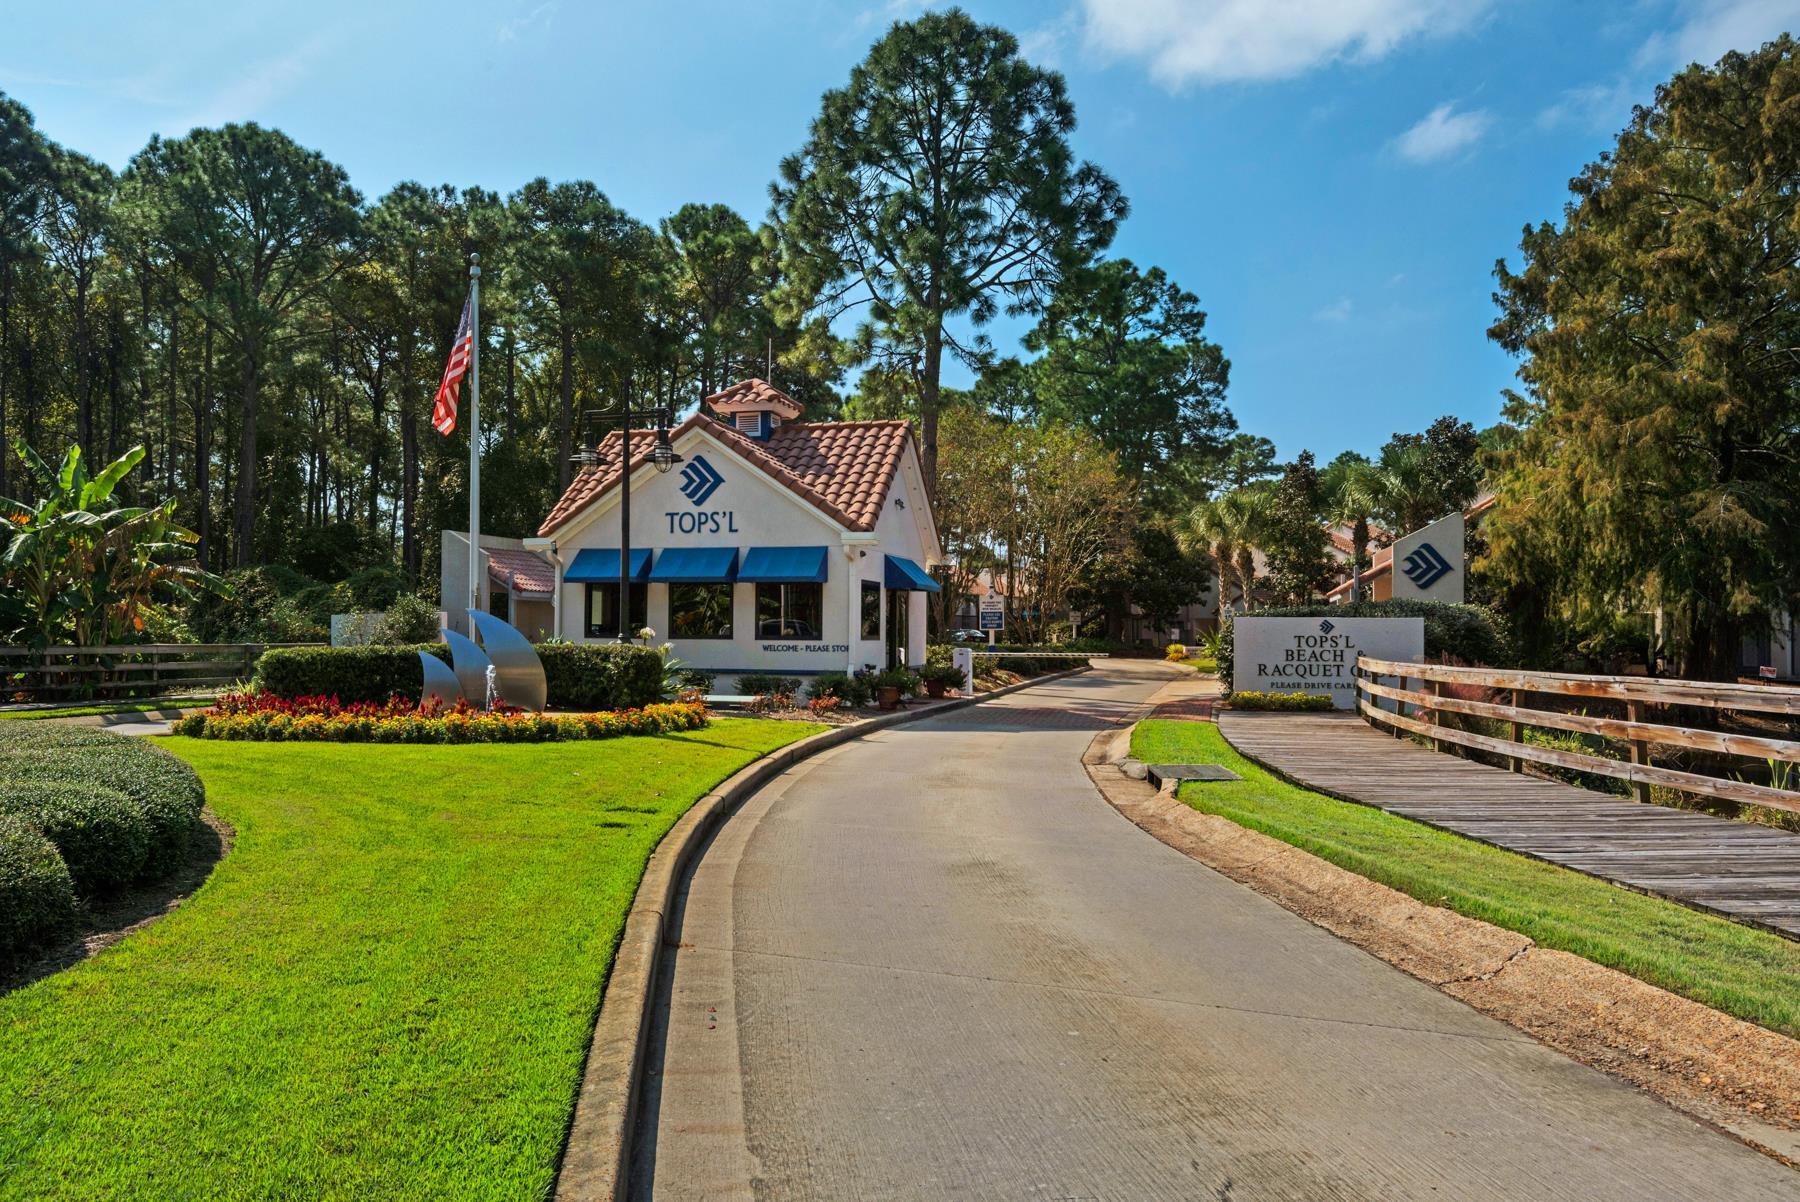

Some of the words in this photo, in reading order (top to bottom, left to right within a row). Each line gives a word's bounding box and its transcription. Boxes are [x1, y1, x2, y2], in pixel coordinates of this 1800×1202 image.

[665, 511, 739, 534] TOPS'L
[762, 644, 799, 653] WELCOME
[805, 644, 830, 653] PLEASE
[1294, 634, 1355, 649] TOPS'L
[1285, 649, 1345, 663] BEACH
[1257, 663, 1344, 679] RACQUET
[1350, 663, 1397, 678] CL
[1270, 682, 1302, 690] PLEASE
[1304, 682, 1332, 690] DRIVE
